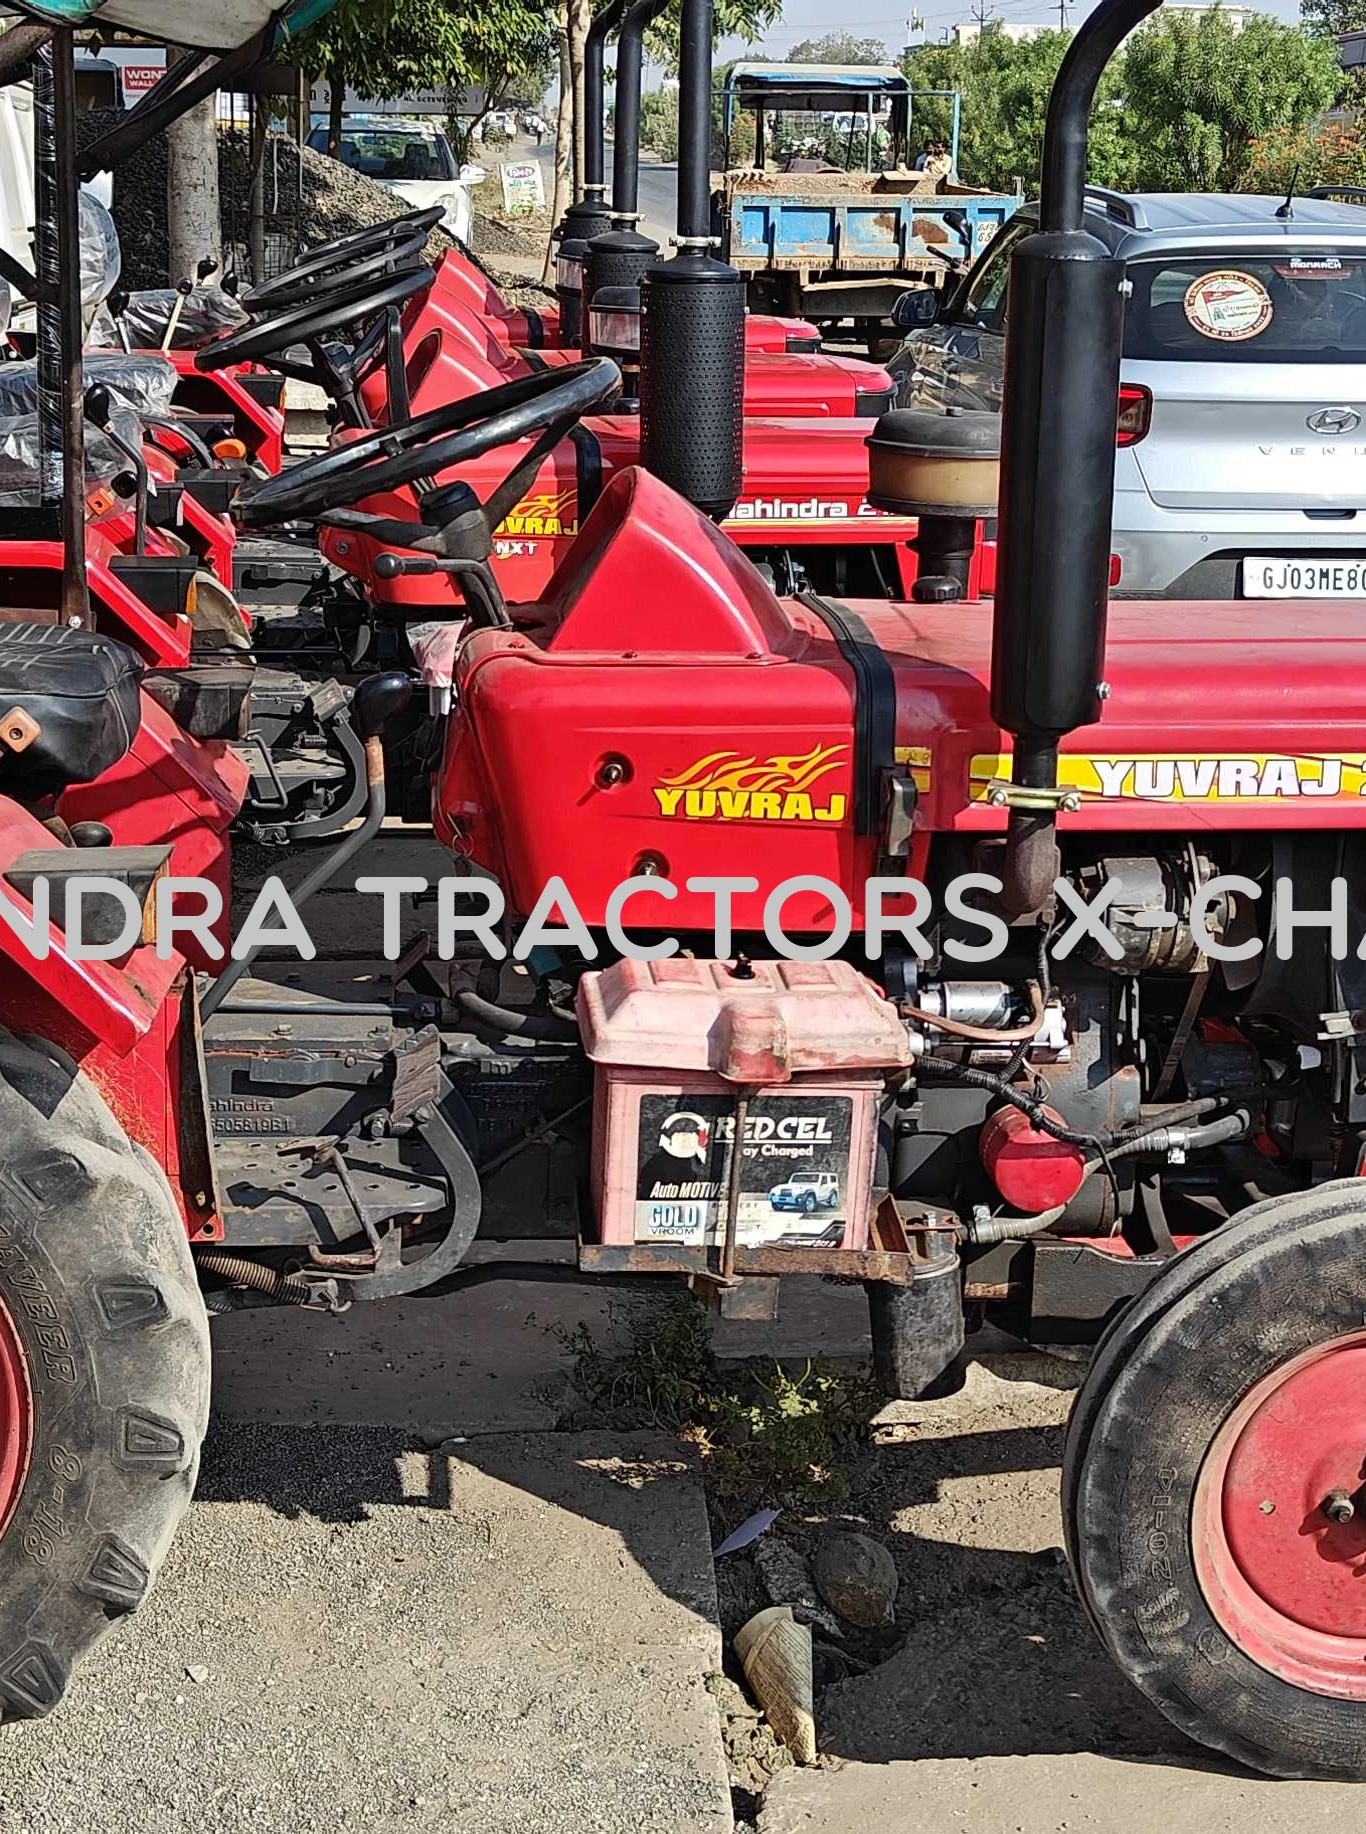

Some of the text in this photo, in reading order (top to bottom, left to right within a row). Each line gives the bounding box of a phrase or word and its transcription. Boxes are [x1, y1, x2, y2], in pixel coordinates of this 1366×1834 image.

[126, 69, 167, 79] WON
[729, 498, 848, 518] ahindra
[496, 541, 538, 555] NXT
[1091, 759, 1341, 799] YUVRAJ
[652, 788, 846, 821] YUVRAJ
[761, 1144, 813, 1159] Charged
[650, 1181, 679, 1199] Auto
[648, 1204, 699, 1228] GOLD
[651, 1228, 695, 1236] VROOM
